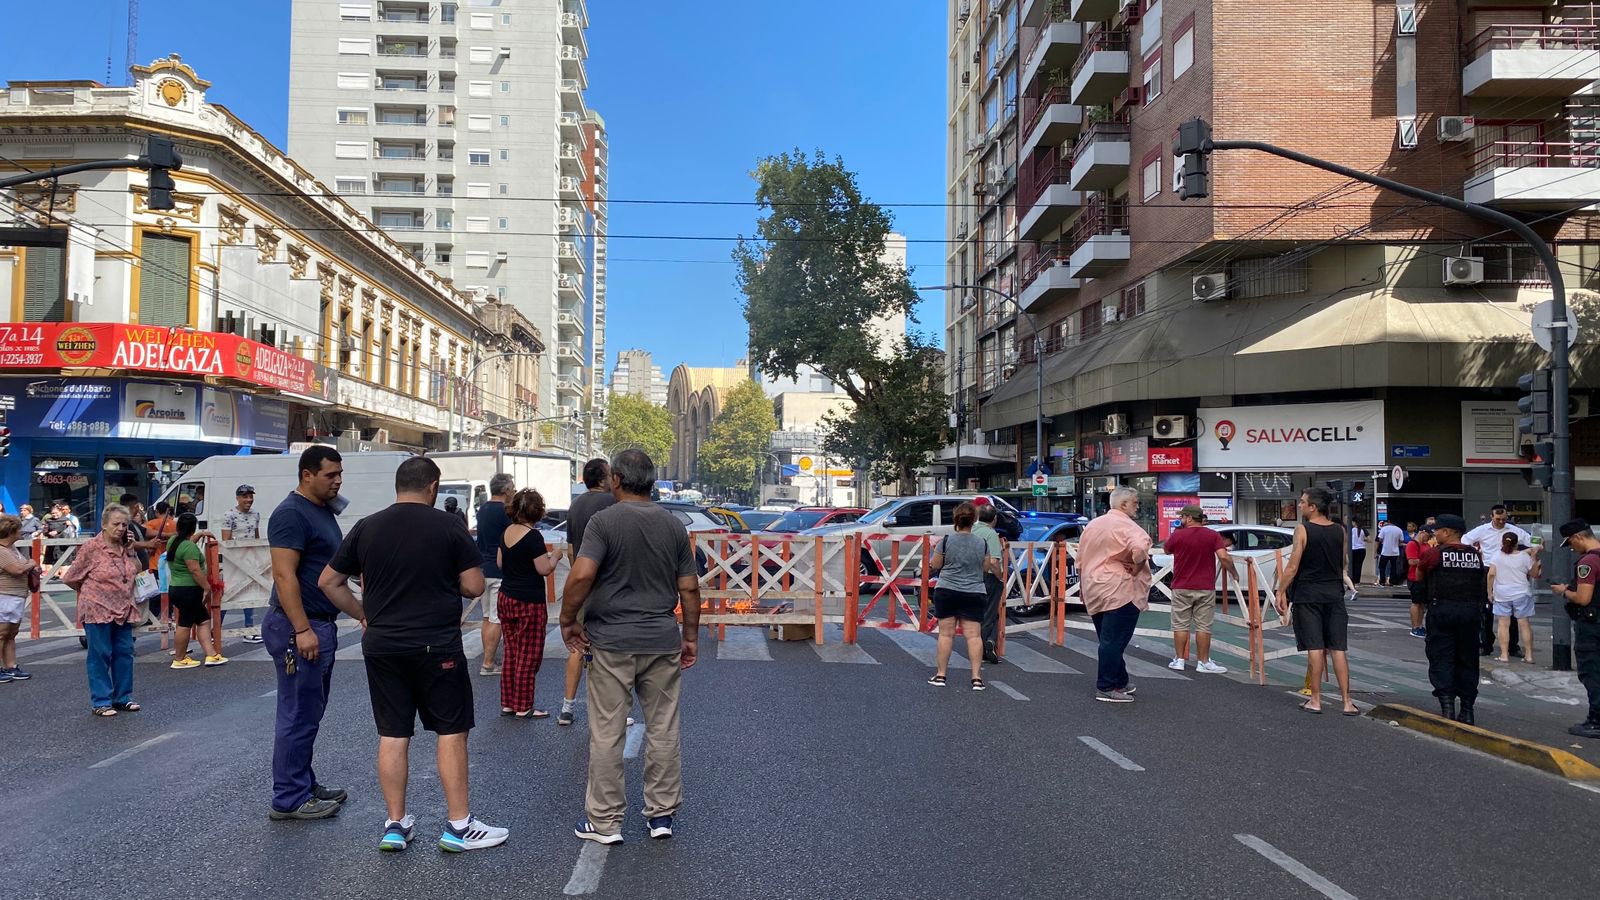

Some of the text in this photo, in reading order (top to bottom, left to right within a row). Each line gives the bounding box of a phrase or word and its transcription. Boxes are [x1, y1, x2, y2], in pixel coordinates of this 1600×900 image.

[20, 327, 45, 346] 14
[125, 328, 216, 349] WEI ZHEN
[58, 342, 95, 350] WEI ZHEN
[112, 341, 224, 374] ADELGAZA
[254, 346, 289, 378] ADELGAZA
[150, 408, 185, 418] Arcoiris
[49, 420, 66, 430] Tel:
[1246, 427, 1358, 444] SALVACELL
[1152, 457, 1180, 465] market
[1442, 552, 1480, 562] POLICIA
